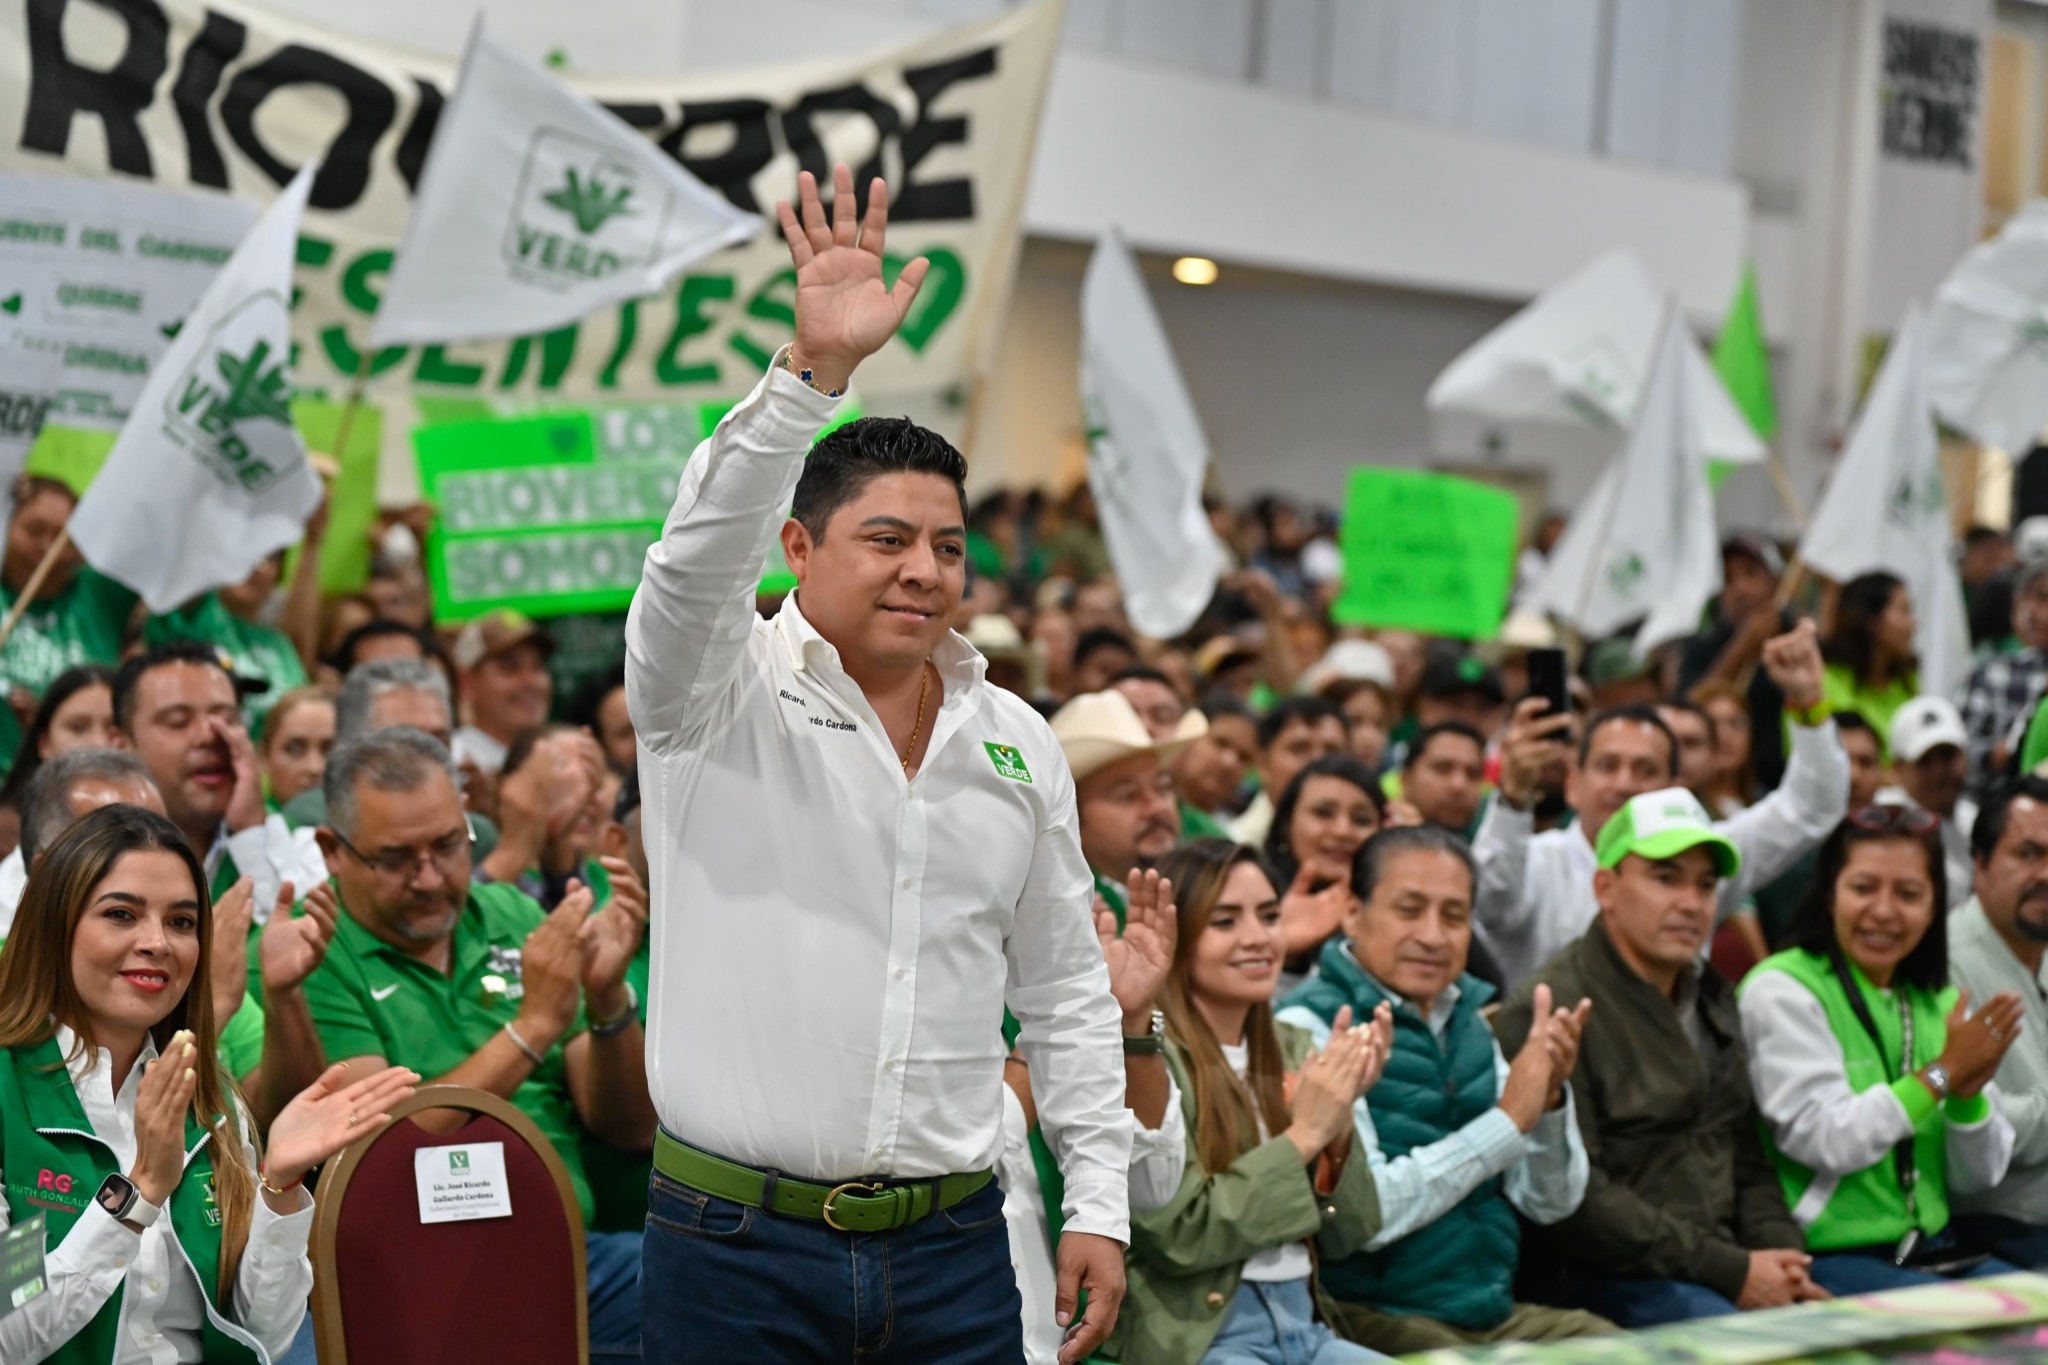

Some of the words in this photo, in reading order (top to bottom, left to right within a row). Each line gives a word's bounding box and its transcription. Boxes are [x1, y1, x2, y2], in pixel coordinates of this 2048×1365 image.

[826, 718, 857, 732] Cardona
[996, 763, 1031, 780] VERDE
[37, 1168, 73, 1193] RG
[447, 1181, 463, 1190] José
[464, 1180, 491, 1189] Ricardo
[9, 1183, 38, 1198] RUTH
[433, 1194, 464, 1203] Gallardo
[464, 1192, 494, 1201] Cardona
